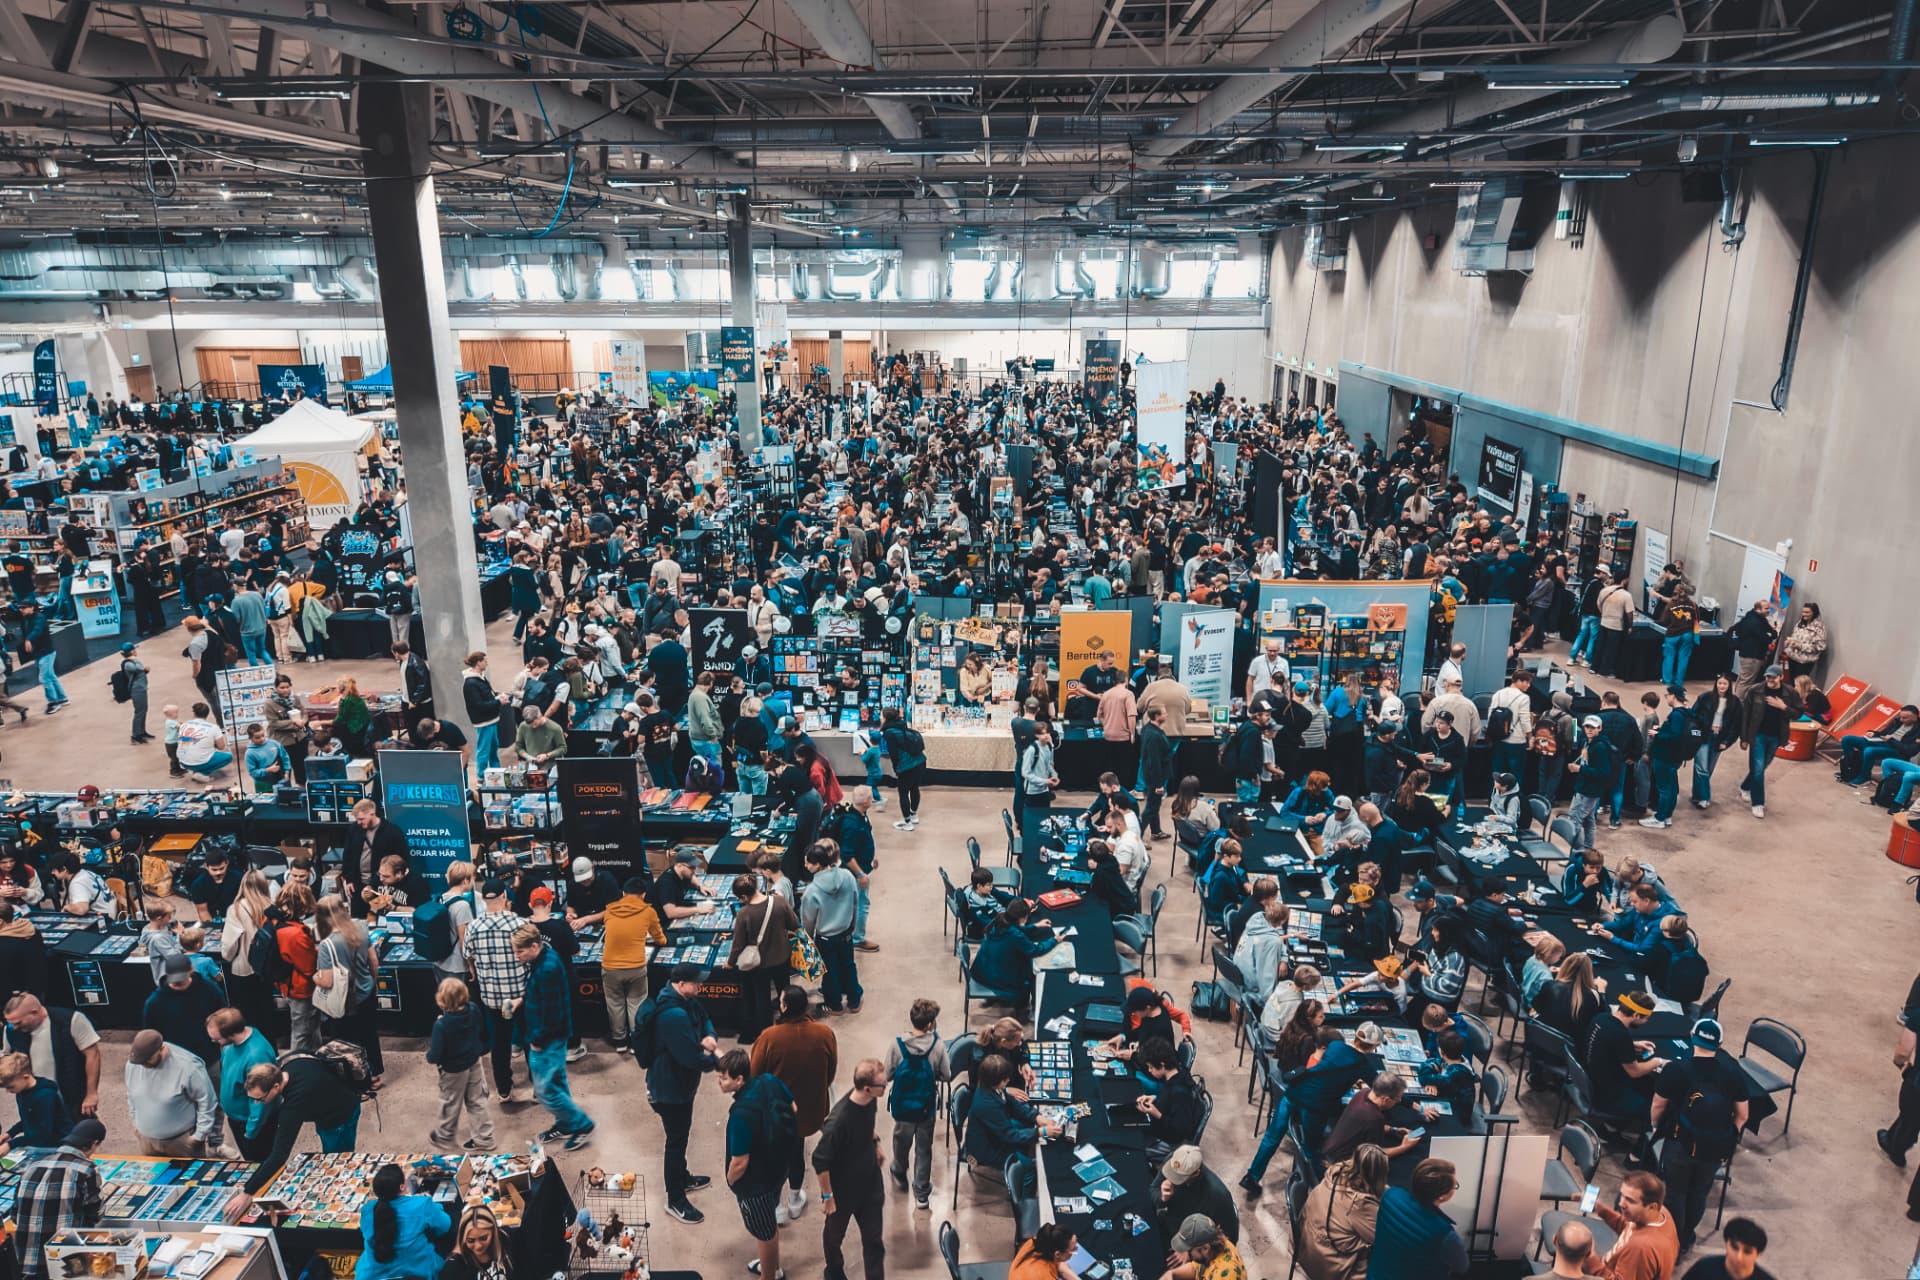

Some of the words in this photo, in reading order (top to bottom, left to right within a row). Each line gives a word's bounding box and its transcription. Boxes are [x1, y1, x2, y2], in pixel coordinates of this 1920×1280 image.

[1086, 365, 1118, 373] POKÉMON
[578, 785, 618, 793] POKEDON
[406, 828, 437, 836] JAKTEN
[439, 828, 451, 836] PÅ
[408, 839, 428, 847] STA
[429, 838, 464, 847] CHASE
[409, 849, 437, 857] ÖRJAR
[439, 848, 456, 857] HÄR
[697, 984, 738, 993] KEDON
